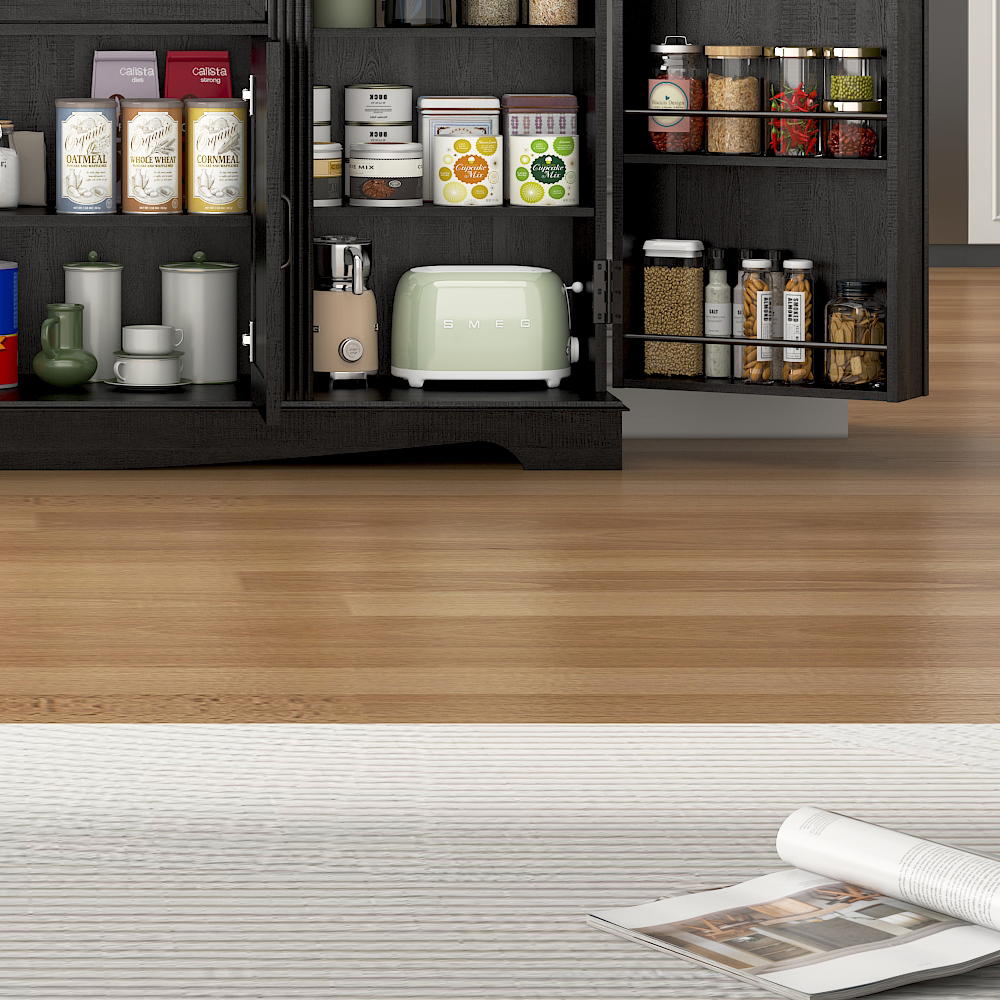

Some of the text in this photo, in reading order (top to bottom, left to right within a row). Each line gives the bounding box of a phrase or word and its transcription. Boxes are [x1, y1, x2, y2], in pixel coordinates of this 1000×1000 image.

[120, 67, 154, 76] calista
[192, 67, 227, 76] calista
[64, 122, 106, 152] Organic
[130, 122, 172, 152] Organic
[196, 122, 237, 153] Organic
[66, 155, 107, 164] OATMEAL
[197, 155, 240, 163] CORNMEAL
[443, 318, 531, 329] SMEG
